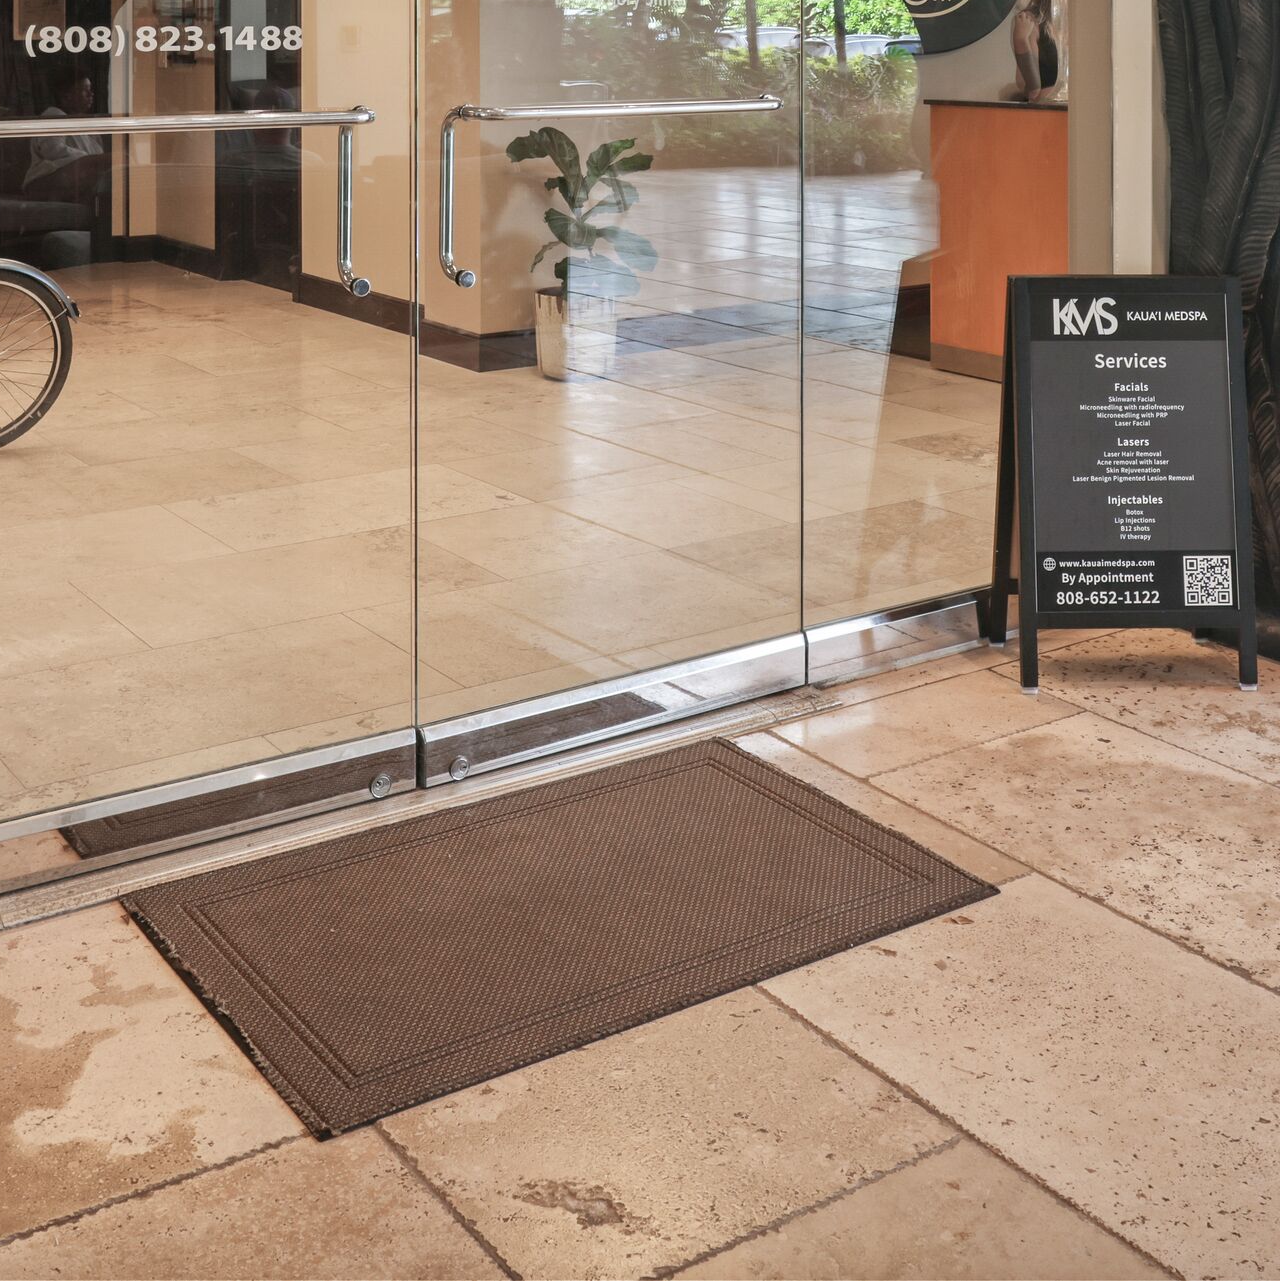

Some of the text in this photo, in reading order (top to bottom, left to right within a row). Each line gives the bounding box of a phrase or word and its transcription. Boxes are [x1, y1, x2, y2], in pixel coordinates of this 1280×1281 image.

[24, 24, 303, 58] (808) 823.1488
[1052, 297, 1119, 336] KMS
[1164, 311, 1208, 321] MEDSPA
[1094, 353, 1167, 368] Services
[1114, 382, 1149, 391] Facials
[1117, 437, 1150, 446] Lasers
[1108, 495, 1163, 506] Injectables
[1059, 559, 1155, 568] www.kauaimedspa.com
[1062, 572, 1154, 585] By Appointment
[1056, 591, 1160, 605] 808-652-1122
